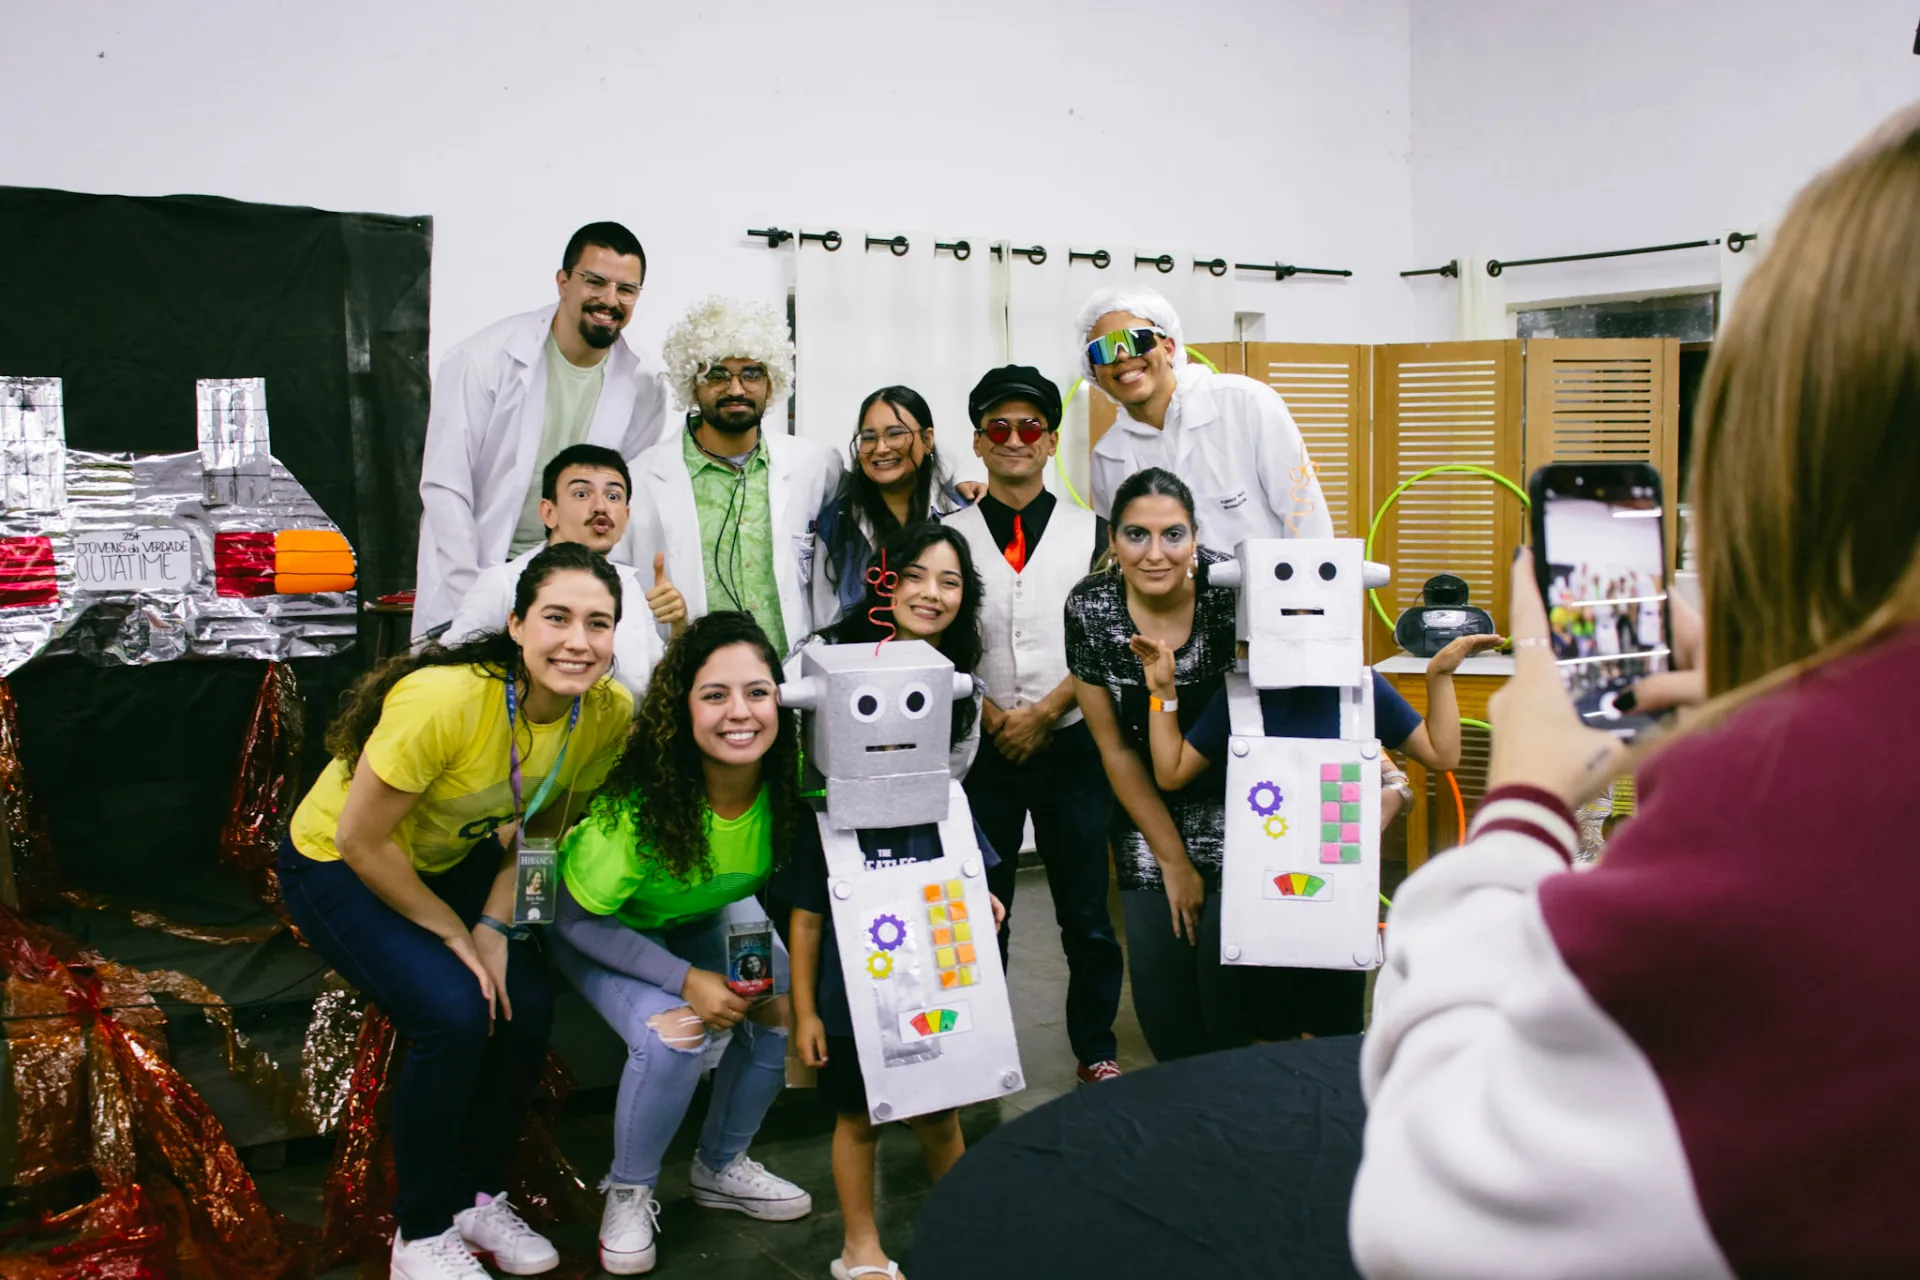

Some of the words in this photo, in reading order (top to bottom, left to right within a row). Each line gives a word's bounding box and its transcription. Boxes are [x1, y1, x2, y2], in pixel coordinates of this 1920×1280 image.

[77, 542, 126, 554] JOVENS
[142, 541, 188, 553] VERDADE
[76, 553, 176, 582] OUTATIME
[877, 849, 892, 857] THE
